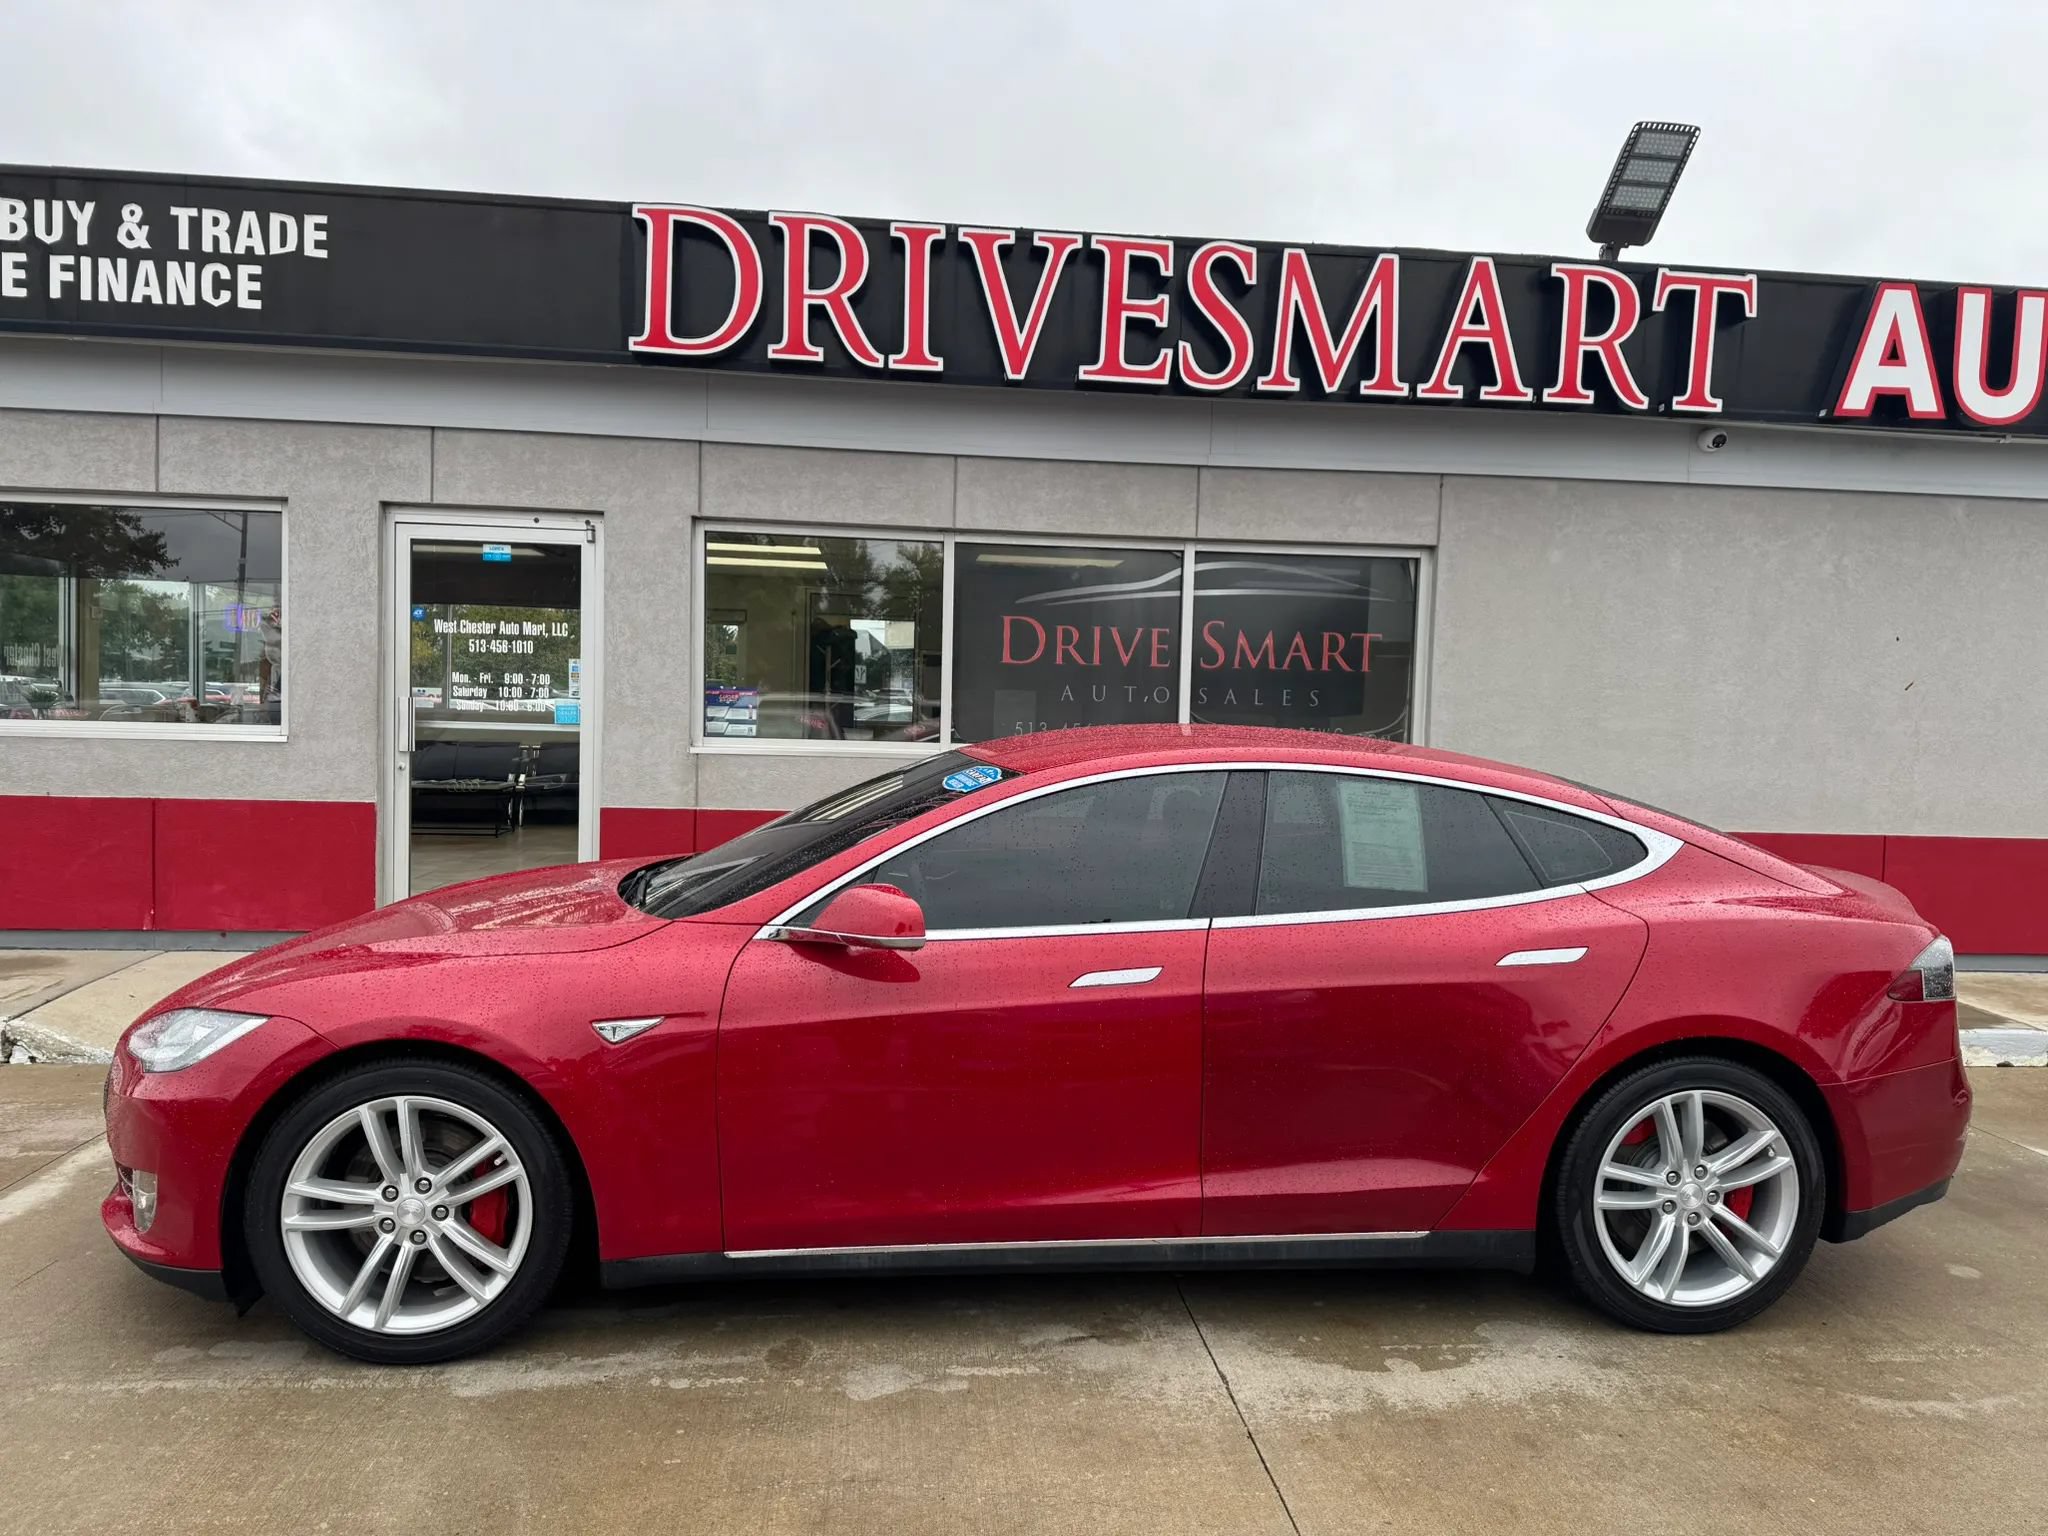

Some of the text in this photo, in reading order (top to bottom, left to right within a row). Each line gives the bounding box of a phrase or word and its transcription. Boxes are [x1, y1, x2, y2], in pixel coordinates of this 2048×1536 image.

[0, 197, 328, 258] BUY & TRADE
[2, 252, 262, 310] E FINANCE
[629, 203, 1757, 412] DRIVESMART
[1834, 281, 2048, 425] AU
[434, 619, 568, 638] West Chester Auto Mart, LLC
[1000, 615, 1382, 672] DRIVE SMART
[452, 672, 471, 683] Mon.
[531, 674, 550, 685] 7:00
[453, 686, 487, 698] Saturday
[499, 687, 522, 698] 10:00
[530, 687, 549, 698] 7:00
[1061, 685, 1320, 707] AUTO SALES
